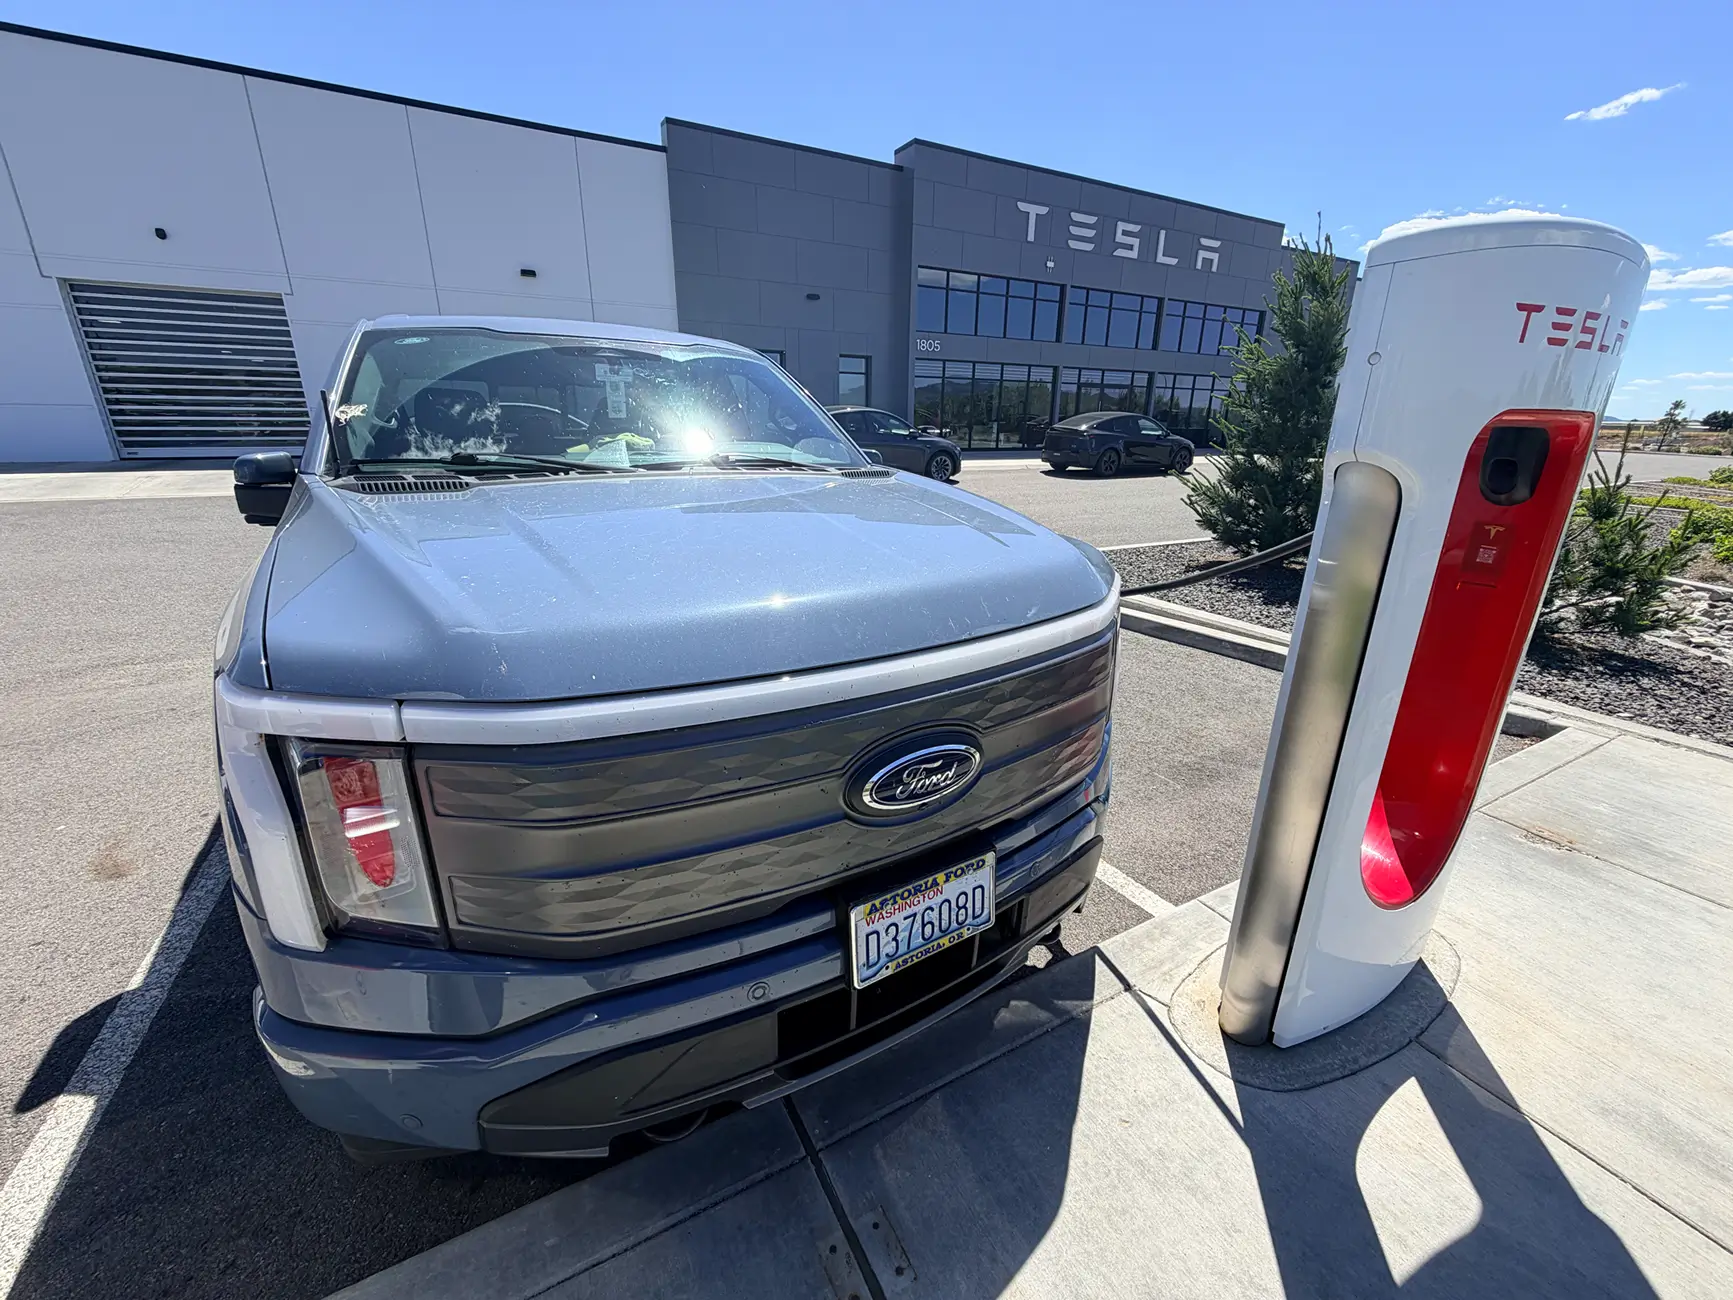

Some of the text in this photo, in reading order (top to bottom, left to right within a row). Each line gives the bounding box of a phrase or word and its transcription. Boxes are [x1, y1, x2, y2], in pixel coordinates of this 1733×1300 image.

[1017, 201, 1222, 273] TESLA
[916, 339, 941, 352] 1805
[1516, 302, 1629, 356] TESLA
[895, 759, 958, 800] Ford
[865, 885, 944, 927] WASHINGTON
[867, 857, 986, 916] ASTORIA FORD
[865, 884, 985, 971] D37608D
[893, 931, 965, 972] ASTORIA, OR
